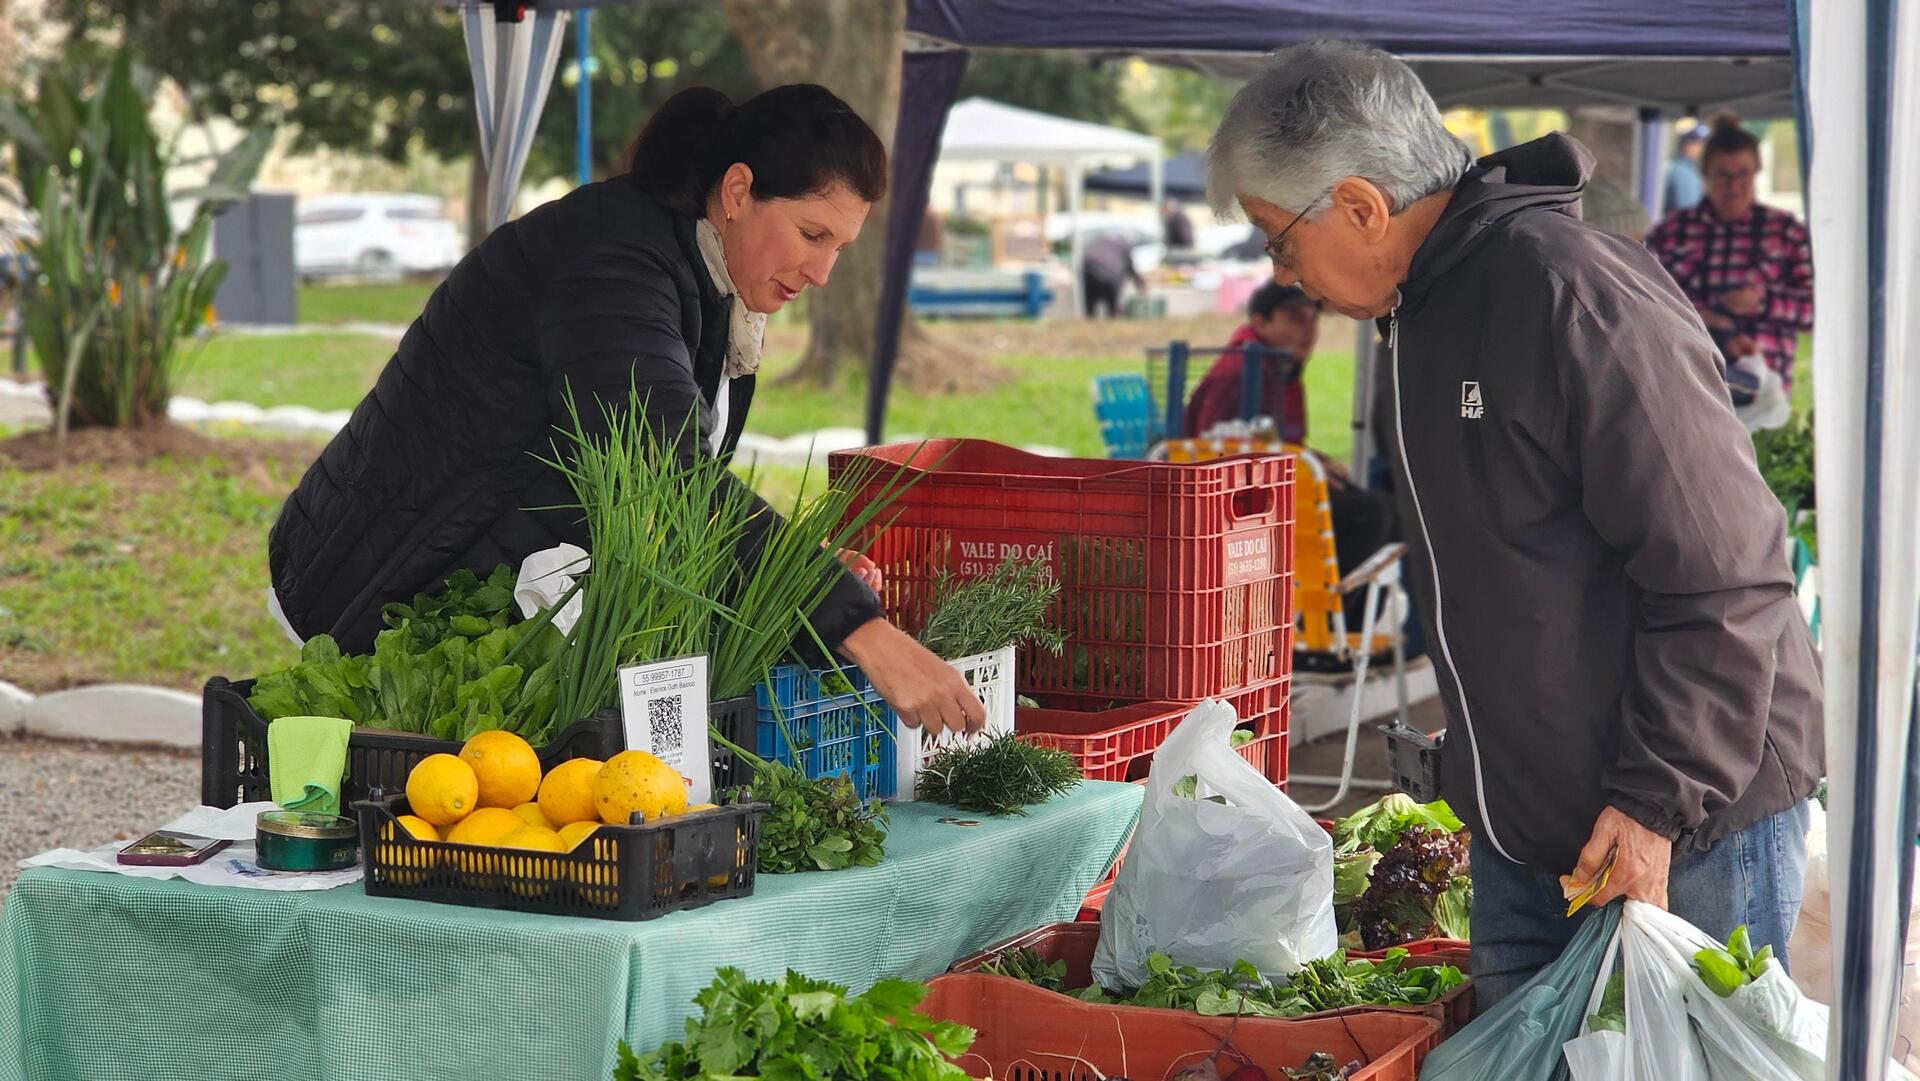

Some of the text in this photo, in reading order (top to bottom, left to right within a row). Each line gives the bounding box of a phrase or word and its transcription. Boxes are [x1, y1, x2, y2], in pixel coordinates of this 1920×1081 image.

[960, 540, 1053, 561] VALE DO CAÍ
[1227, 534, 1267, 559] VALE DO CAÍ
[960, 561, 984, 576] (51)
[642, 668, 685, 684] 55 99957-1787
[633, 689, 647, 697] Nome
